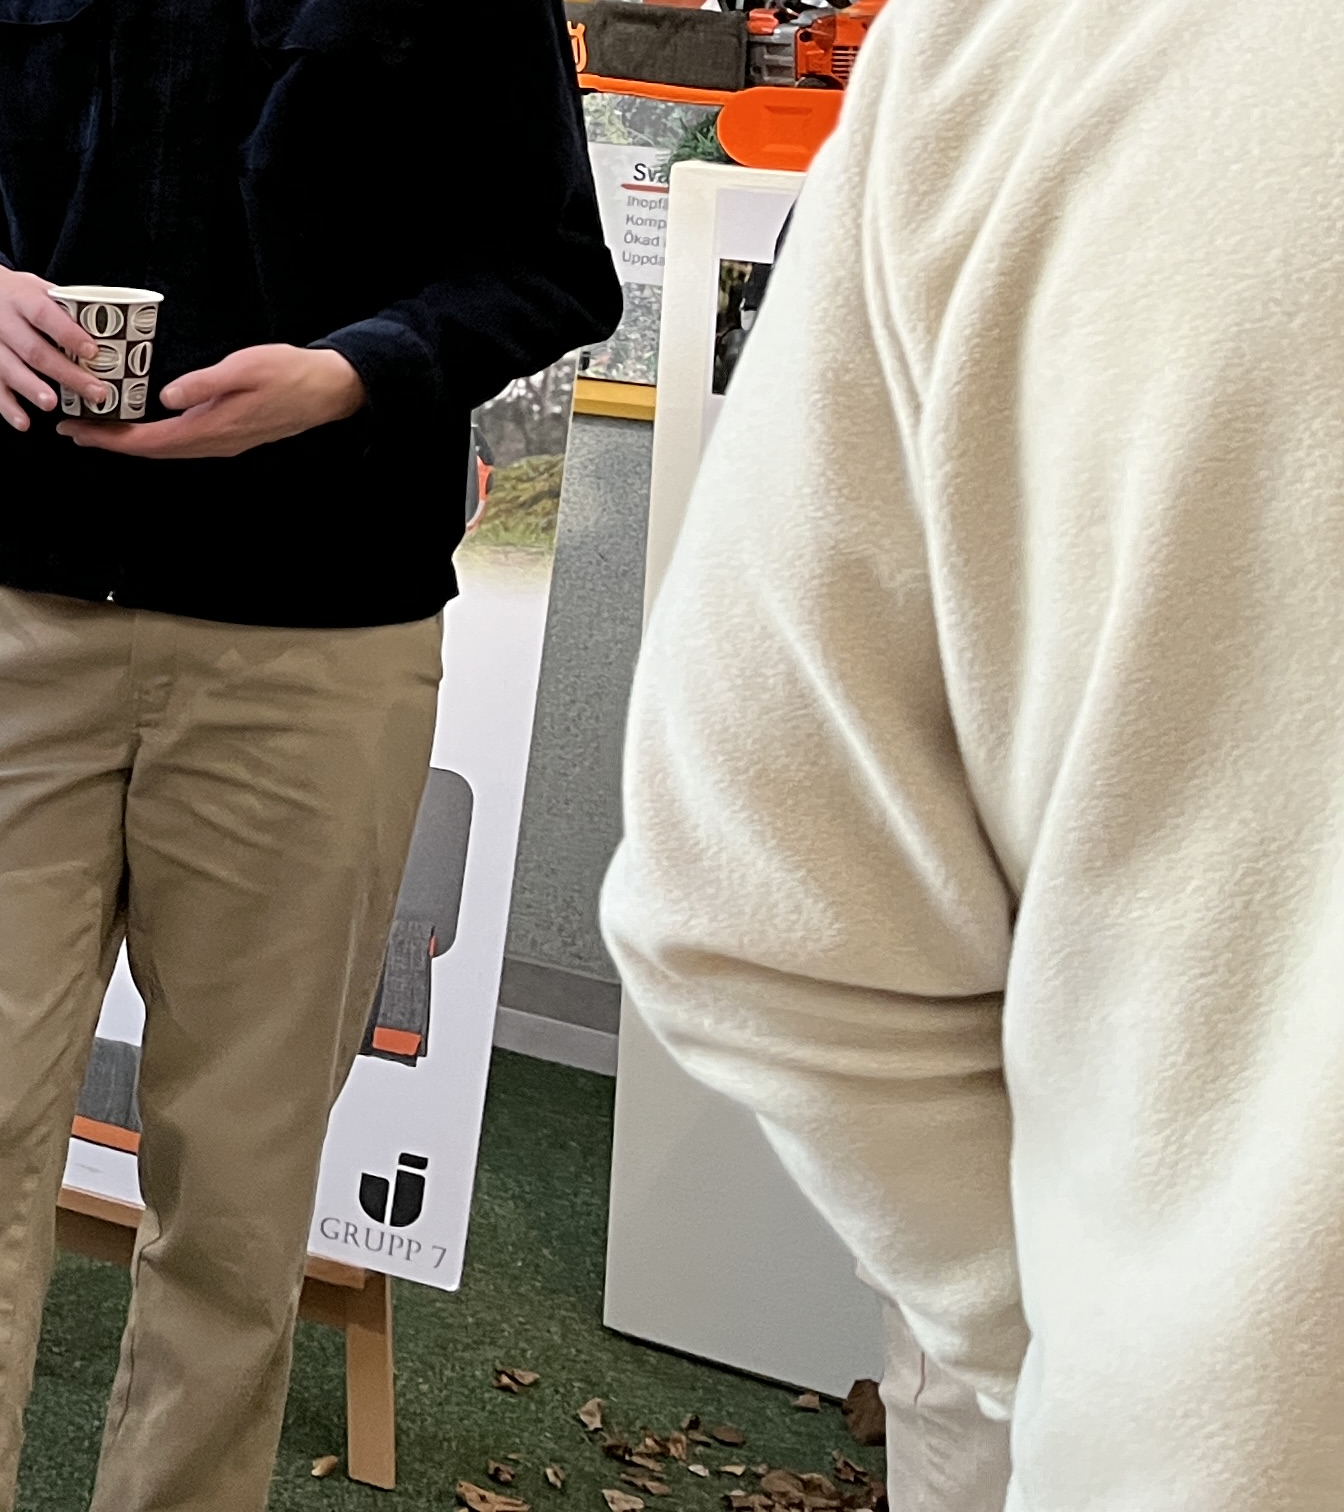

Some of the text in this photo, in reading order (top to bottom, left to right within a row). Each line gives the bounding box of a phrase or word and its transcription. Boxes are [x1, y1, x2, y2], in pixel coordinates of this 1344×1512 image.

[623, 229, 660, 247] Ökad
[320, 1216, 447, 1269] GRUPP 7
